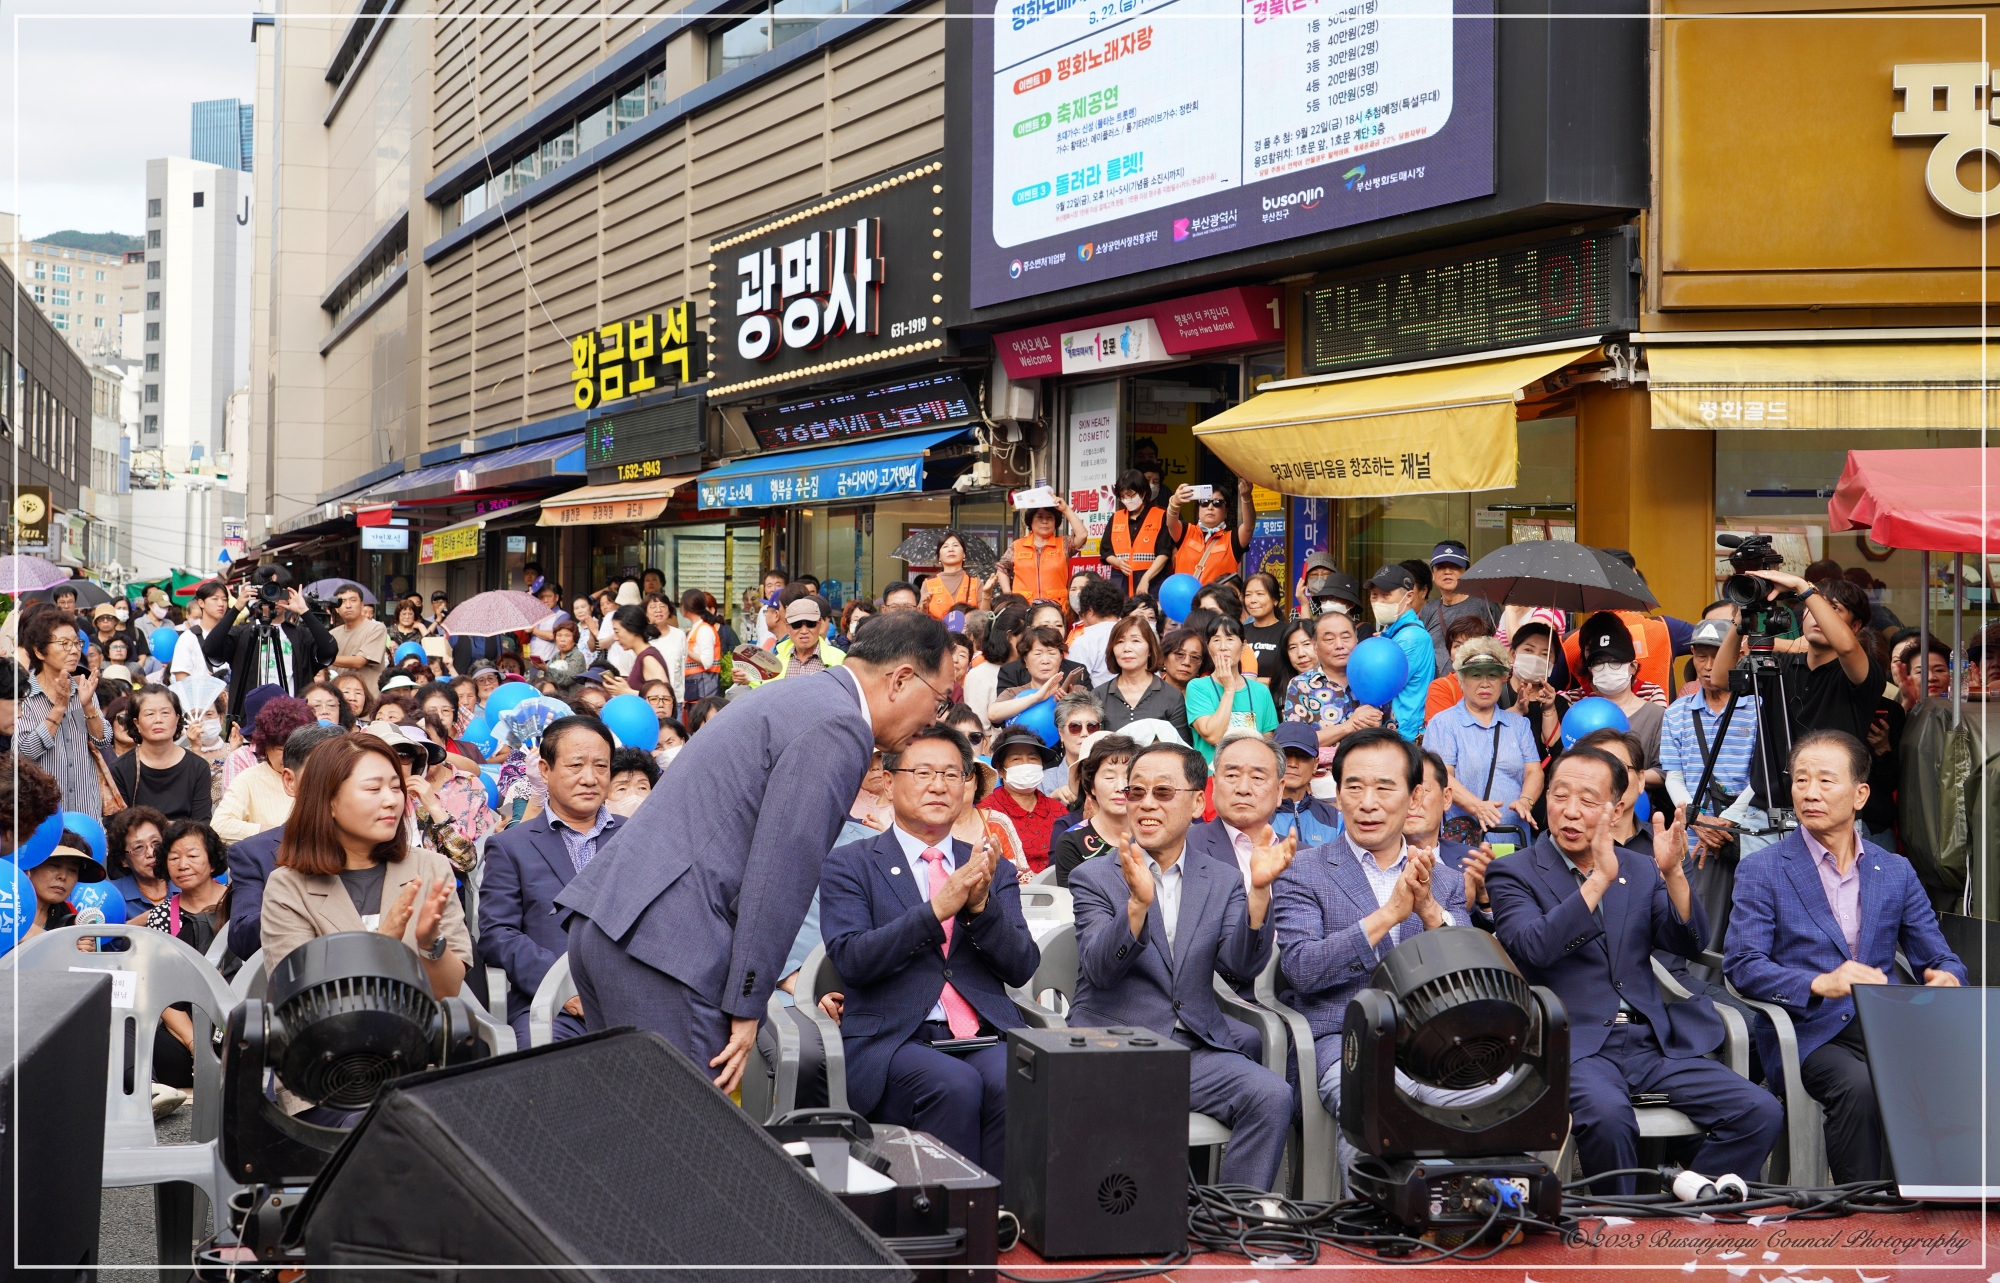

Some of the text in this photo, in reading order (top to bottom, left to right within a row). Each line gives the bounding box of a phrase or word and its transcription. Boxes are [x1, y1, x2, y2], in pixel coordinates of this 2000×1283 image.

[1306, 20, 1379, 54] 2등 40만원(2명)
[1307, 19, 1321, 34] 1등
[1057, 25, 1153, 81] 평화노래자랑
[1306, 40, 1379, 74] 3등 30만원(2명)
[1306, 61, 1379, 94] 4등 20만원(3명)
[1056, 85, 1119, 124] 축제공연
[1306, 81, 1379, 113] 5등 10만원(5명)
[1295, 126, 1309, 140] 9월
[1310, 117, 1343, 135] 22일(금)
[1345, 112, 1363, 125] 18시
[1364, 89, 1441, 119] 추첨예정(특설무대)
[1296, 143, 1316, 157] 1호문
[1330, 133, 1351, 148] 1호문
[1056, 151, 1144, 197] 돌려라 룰렛!
[1017, 188, 1040, 203] 이벤트
[1056, 199, 1065, 212] 9월
[1092, 189, 1104, 203] 오후
[1262, 186, 1324, 211] busanjin
[1191, 208, 1238, 231] 부산광역시
[1261, 209, 1290, 223] 부산진구
[736, 216, 884, 360] 광명사
[1174, 309, 1194, 327] 행복이
[1203, 305, 1230, 320] 커집니다
[1266, 298, 1281, 329] 1
[890, 316, 927, 339] 631-1919
[1179, 320, 1235, 339] Pyung Hwa Market
[571, 302, 696, 410] 황금보석
[1012, 336, 1052, 355] 어서오세요
[1019, 353, 1053, 367] Welcome
[1079, 416, 1110, 430] SKIN HEALTH
[1698, 400, 1789, 422] 평화골드
[1079, 429, 1110, 443] COSMETIC
[617, 460, 661, 480] T.632-1943
[1270, 451, 1432, 482] 멋과 아름다움을 창조하는 채널
[770, 477, 793, 502] 행복을
[795, 475, 819, 499] 주는집
[1071, 489, 1099, 513] 커피숍
[1599, 634, 1611, 647] C
